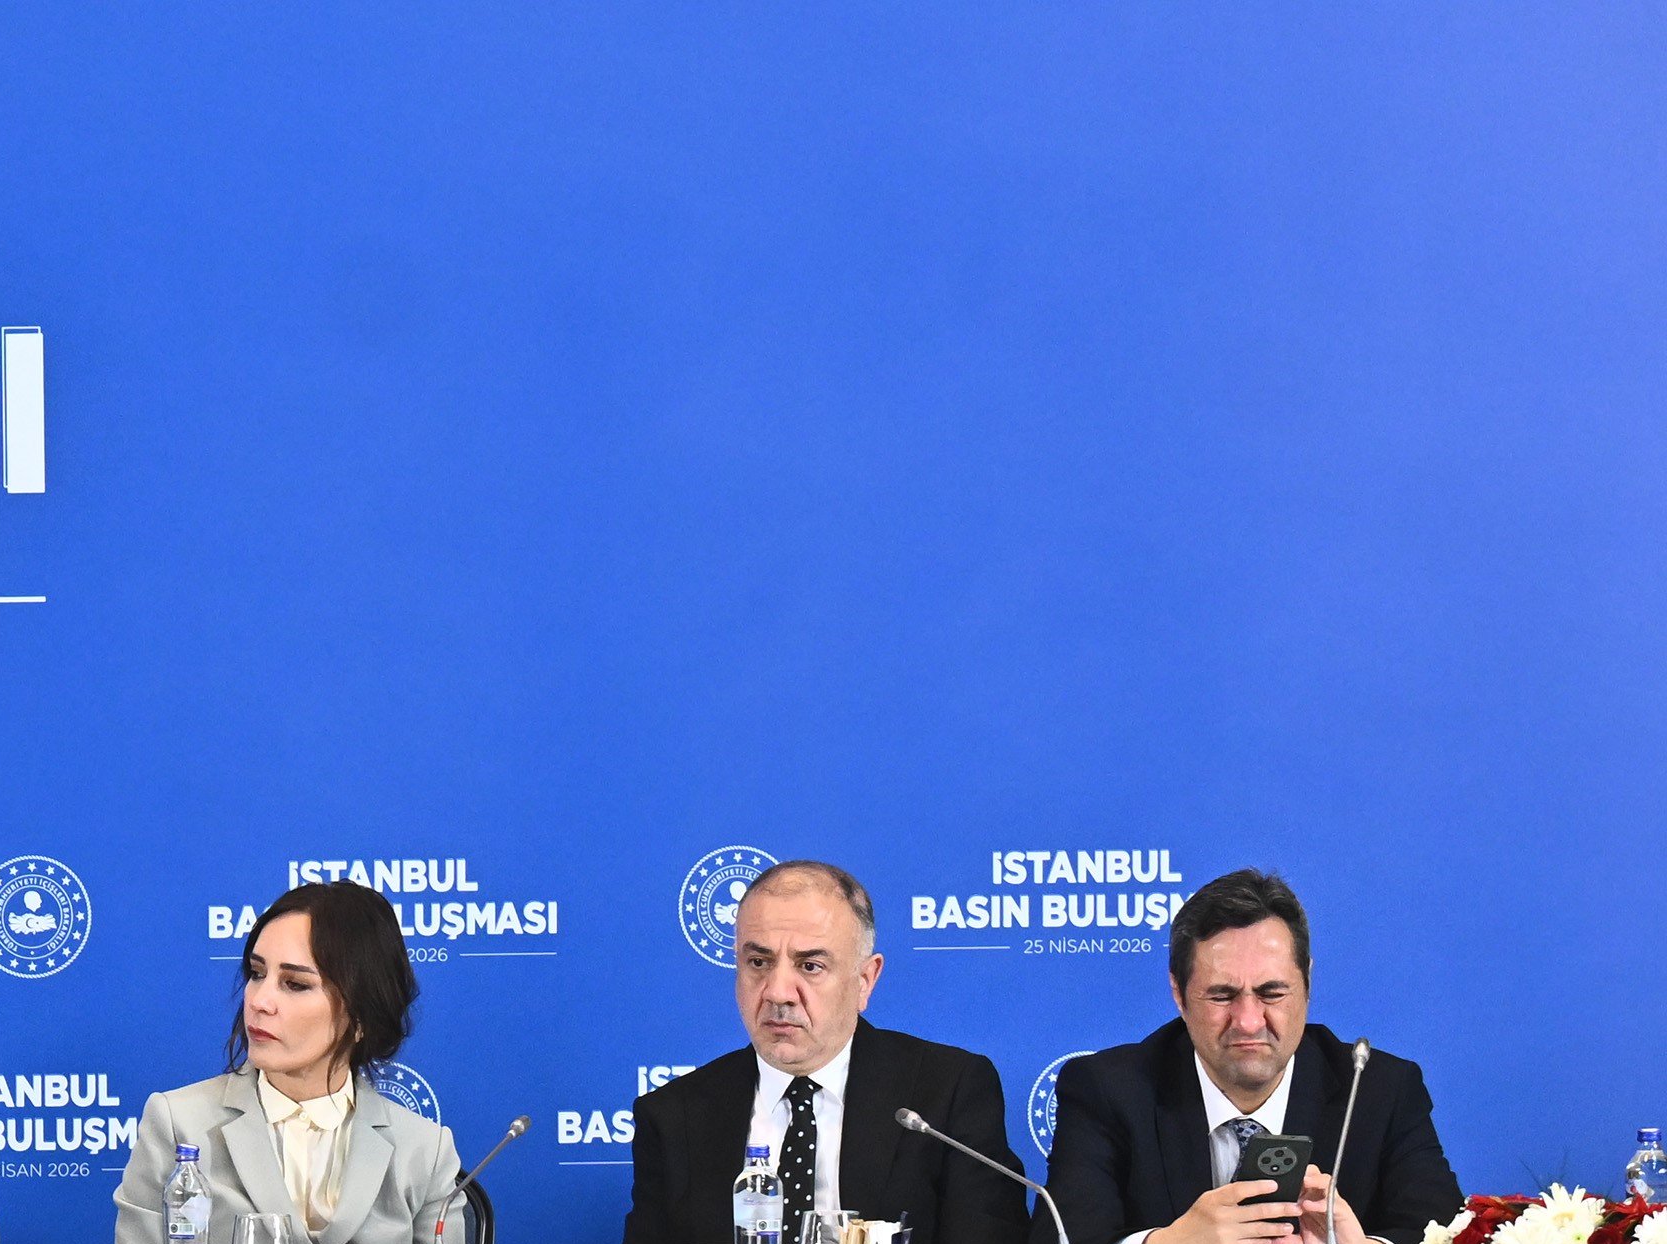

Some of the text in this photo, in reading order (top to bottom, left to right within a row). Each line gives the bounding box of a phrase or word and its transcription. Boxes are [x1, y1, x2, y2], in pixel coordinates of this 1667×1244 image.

[992, 849, 1183, 885] İSTANBUL
[399, 901, 558, 940] LUŞMASI
[911, 893, 1196, 931] BASIN BULUŞ
[407, 947, 449, 963] 2026
[1023, 938, 1152, 954] 25 NİSAN 2026
[557, 1110, 636, 1144] BAS
[48, 1162, 90, 1177] 2026
